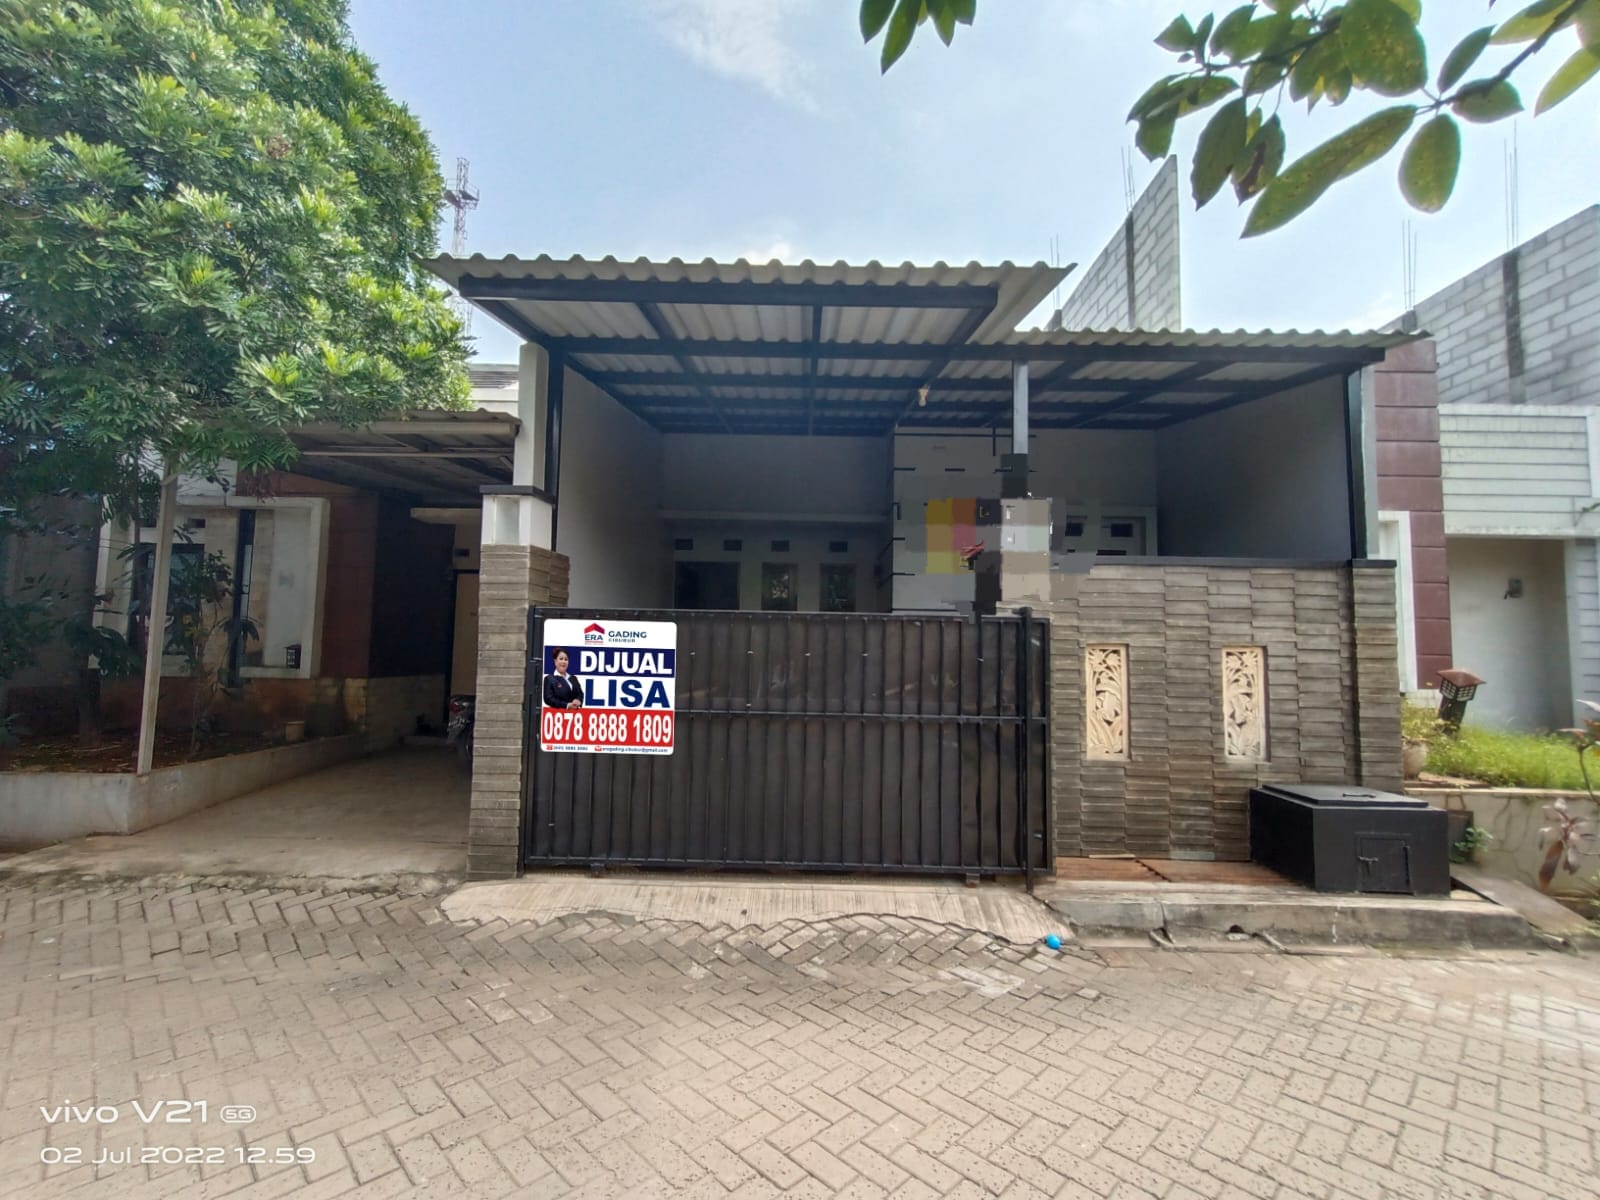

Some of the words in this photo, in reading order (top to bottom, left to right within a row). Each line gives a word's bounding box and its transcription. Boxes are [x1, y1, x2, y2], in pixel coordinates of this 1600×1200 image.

[608, 630, 647, 638] GADING
[580, 650, 673, 675] DIJUAL
[584, 678, 671, 708] LISA
[543, 711, 583, 741] 0878
[587, 712, 628, 743] 8888
[633, 714, 672, 744] 1809
